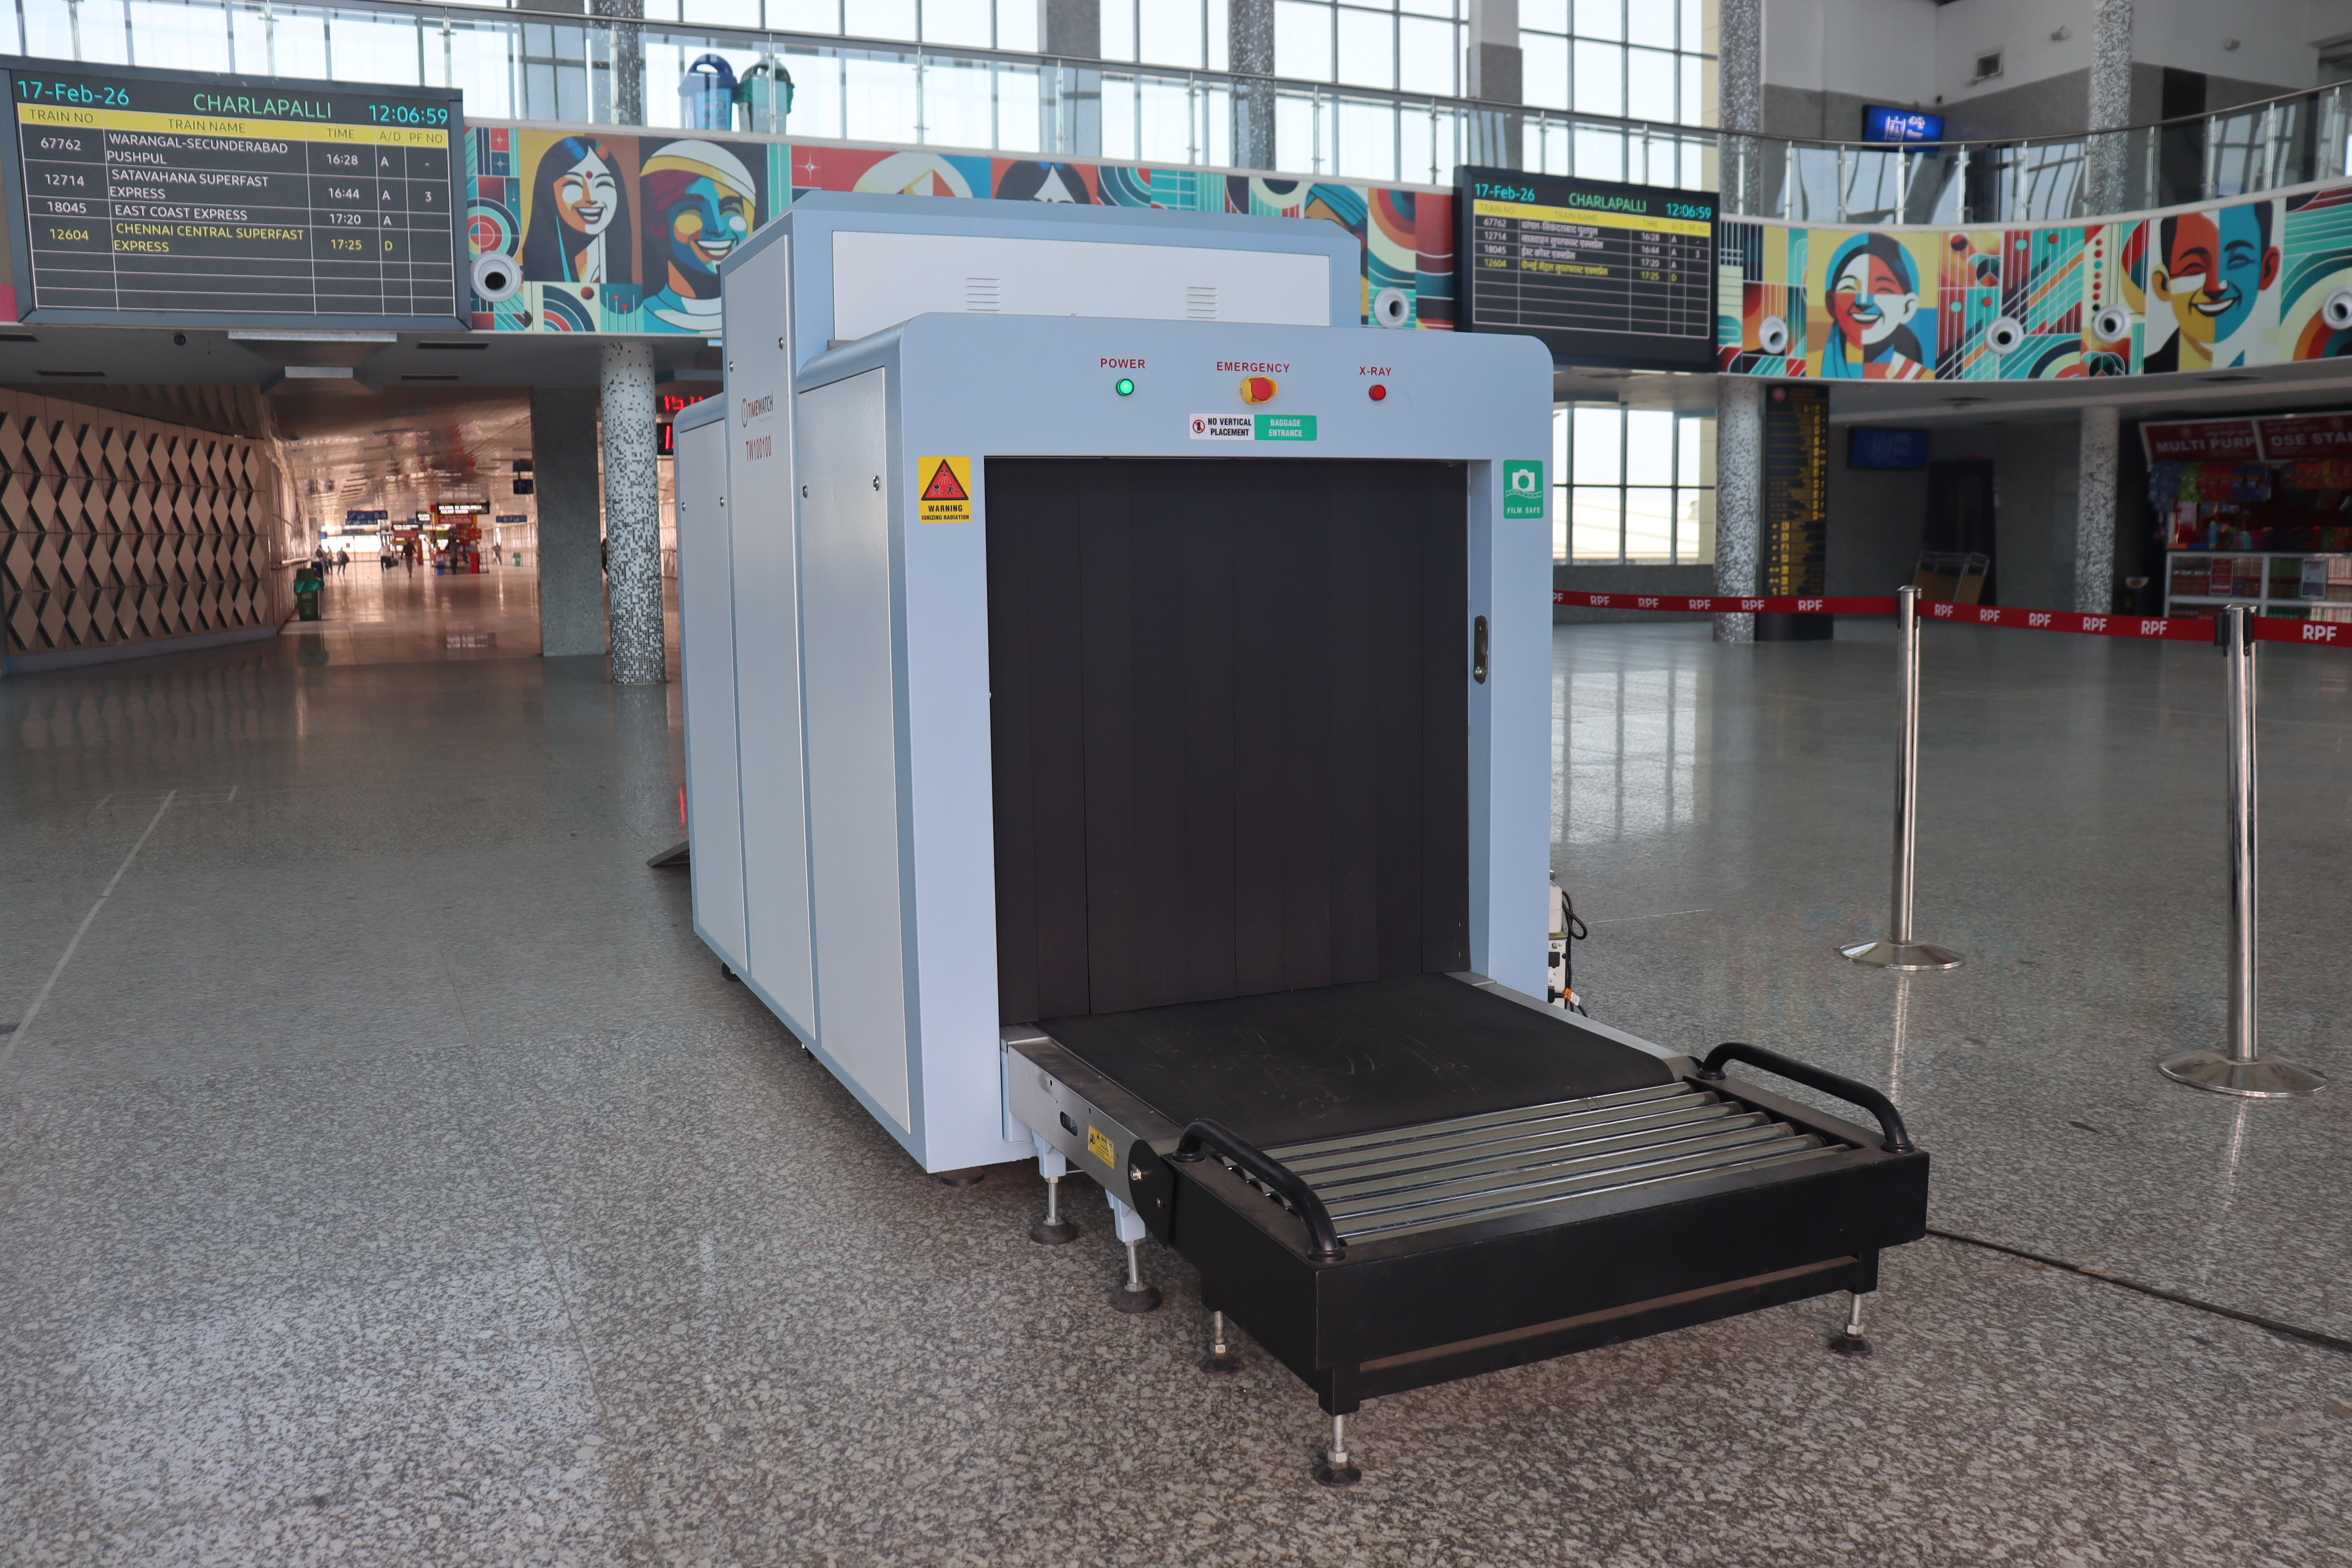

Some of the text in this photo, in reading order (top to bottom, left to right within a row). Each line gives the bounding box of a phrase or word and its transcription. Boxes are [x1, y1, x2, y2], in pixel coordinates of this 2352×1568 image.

[18, 80, 129, 105] 17-Feb-26
[194, 94, 330, 117] CHARLAPALLI
[29, 109, 93, 123] TRAIN NO
[369, 105, 447, 124] 12:06:59
[168, 118, 245, 132] TRAIN NAME
[327, 128, 354, 139] TIME
[379, 131, 401, 141] A/D
[409, 133, 442, 143] PF NO
[41, 138, 81, 150] 67762
[109, 133, 287, 152] WARANGAL-SECUNDERABAD
[107, 151, 166, 163] PUSHPUL
[327, 154, 358, 165] 16:28
[381, 157, 389, 166] A
[45, 174, 84, 186] 12714
[112, 169, 268, 187] SATAVAHANA SUPERFAST
[110, 186, 165, 198] EXPRESS
[328, 187, 359, 198] 16:44
[382, 190, 390, 200] A
[425, 192, 431, 201] 3
[1475, 183, 1535, 201] 17-Feb-26
[47, 201, 86, 213] 18045
[1480, 203, 1502, 212] TRAIN
[1569, 192, 1646, 212] CHARLAPALLI
[115, 205, 247, 220] EAST COAST EXPRESS
[1555, 211, 1597, 221] TRAIN NAME
[1666, 203, 1711, 219] 12:06:59
[330, 214, 361, 224] 17:20
[383, 216, 391, 225] A
[1484, 218, 1506, 227] 67762
[1643, 220, 1658, 228] TIME
[49, 229, 89, 240] 12604
[116, 223, 303, 239] CHENNAI CENTRAL SUPERFAST
[1485, 231, 1506, 240] 12714
[1641, 232, 1660, 241] 16:28
[114, 240, 169, 252] EXPRESS
[331, 239, 361, 249] 17:25
[385, 241, 392, 250] D
[1485, 245, 1506, 254] 18045
[1641, 245, 1659, 254] 16:44
[1485, 258, 1506, 267] 12604
[1641, 258, 1659, 267] 17:20
[1641, 271, 1660, 281] 17:25
[1671, 274, 1677, 282] D
[1100, 359, 1145, 369] POWER
[1216, 361, 1290, 373] EMERGENCY
[1359, 366, 1392, 376] X-RAY
[748, 394, 773, 418] TIMEWATCH
[1220, 418, 1251, 426] VERTICAL
[1210, 428, 1249, 436] PLACEMENT
[1269, 429, 1303, 437] ENTRANCE
[2270, 433, 2306, 446] OSE
[746, 435, 771, 461] TW100100
[2157, 439, 2205, 452] MULTI
[1590, 595, 1610, 606] RPF
[1638, 597, 1659, 608] RPF
[1689, 599, 1711, 610] RPF
[1742, 599, 1764, 610] RPF
[1798, 600, 1823, 611] RPF
[1935, 604, 1953, 617] RPF
[1980, 609, 2000, 622] RPF
[2029, 613, 2051, 626] RPF
[2082, 617, 2107, 631] RPF
[2141, 620, 2167, 634] RPF
[2303, 624, 2337, 641] RPF
